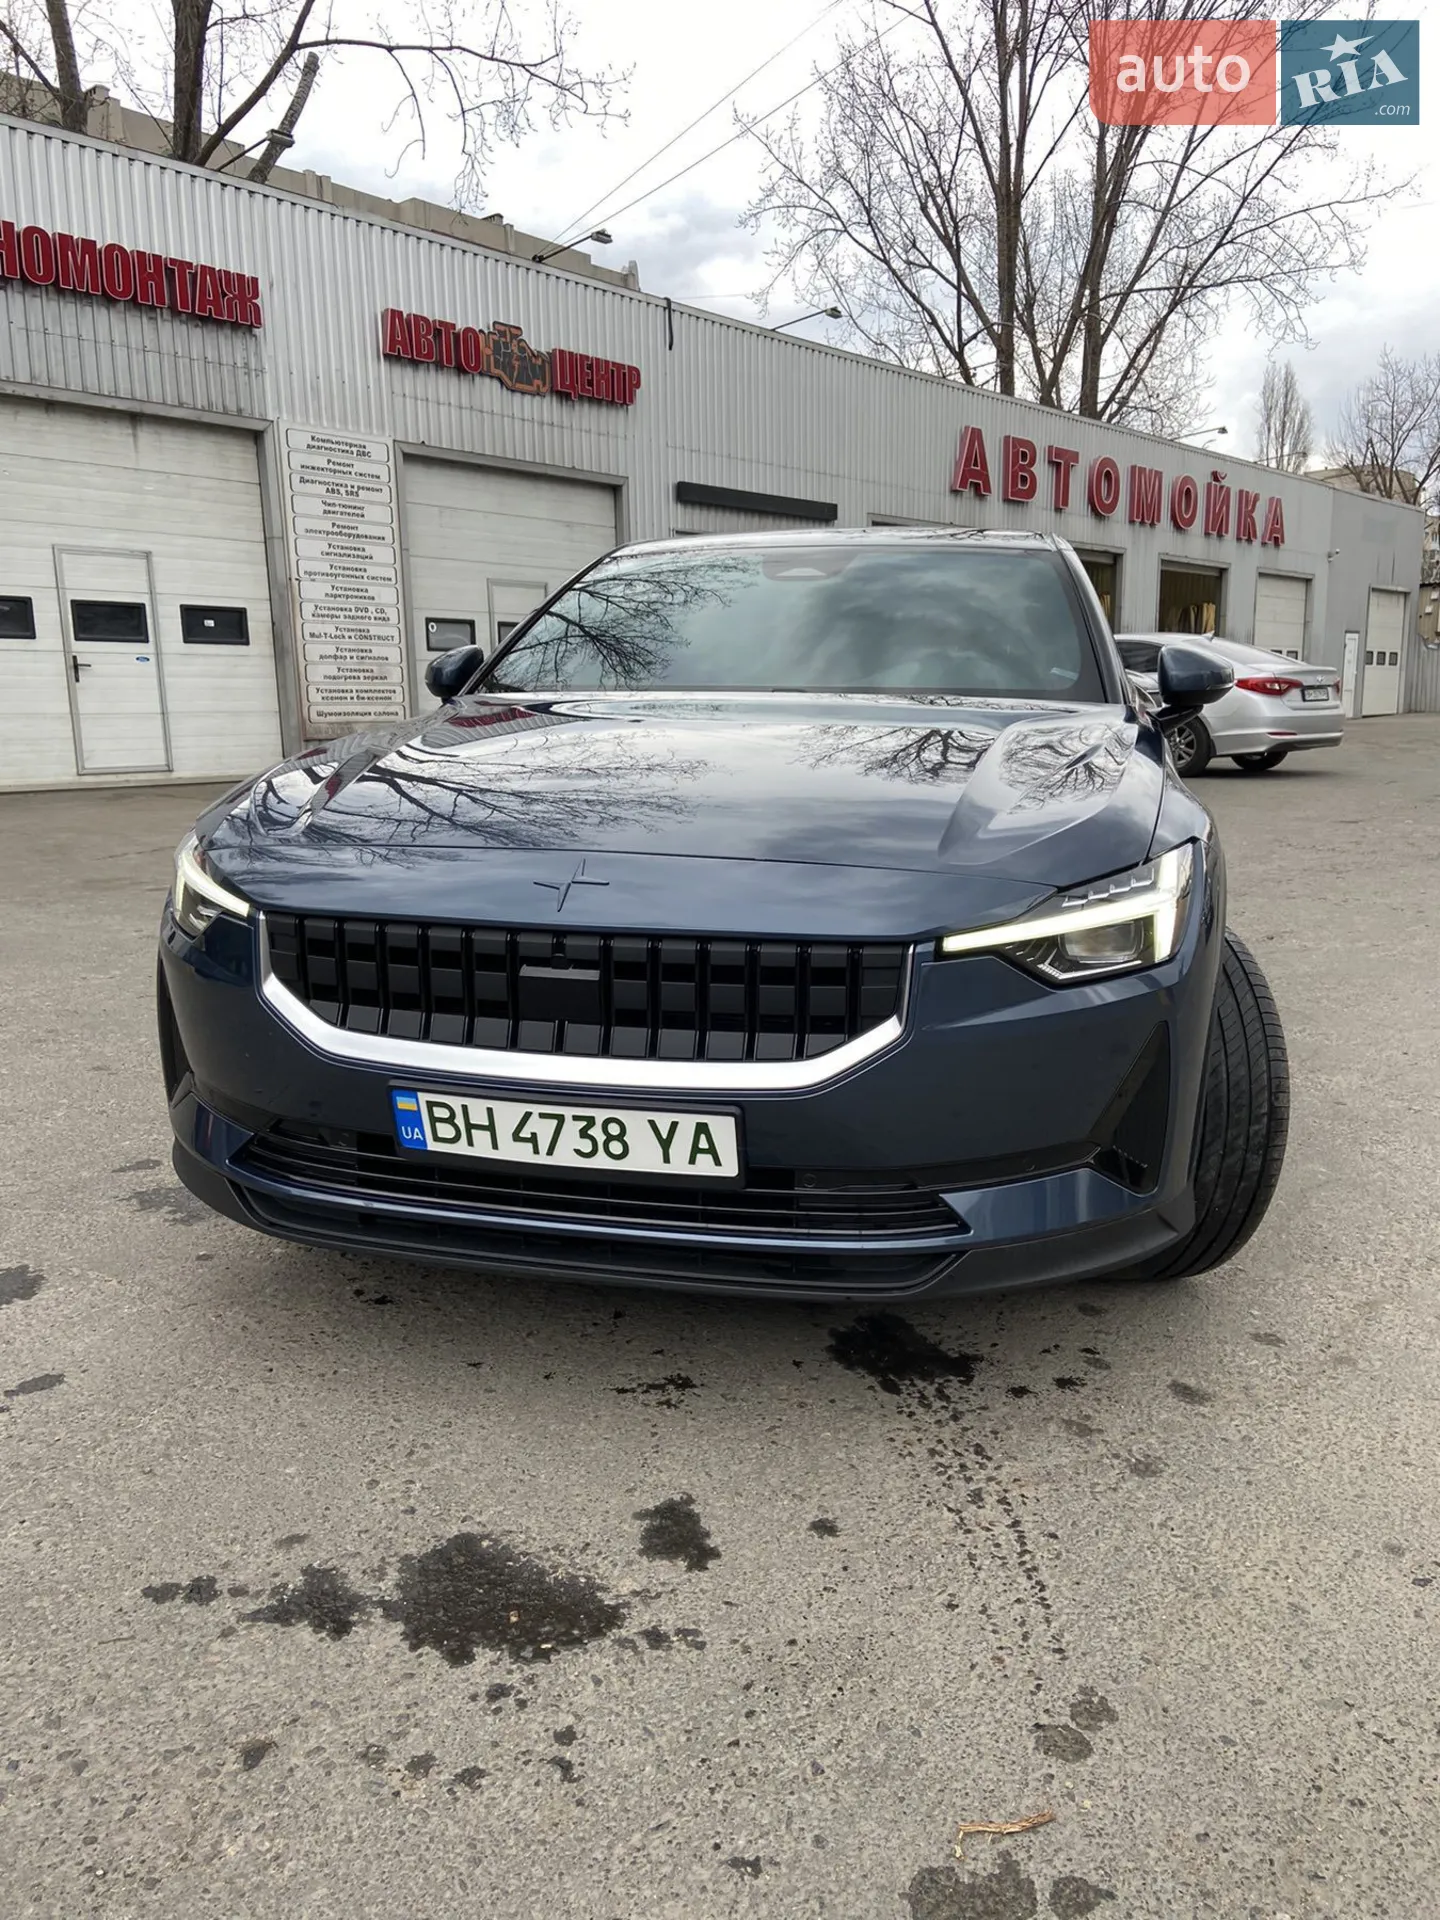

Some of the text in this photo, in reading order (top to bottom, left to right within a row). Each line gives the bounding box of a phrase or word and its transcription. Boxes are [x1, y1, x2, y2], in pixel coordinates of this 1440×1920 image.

[383, 308, 642, 406] АВТО ЦЕНТР
[310, 435, 367, 449] Компьютерная
[306, 444, 372, 458] диагностика ДВС
[326, 459, 355, 468] Ремонт
[300, 464, 381, 480] инжекторных систем
[299, 476, 349, 488] Диагностика
[356, 485, 383, 493] ремонт
[952, 425, 1285, 546] АВТОМОЙКА
[322, 509, 365, 518] двигателей
[331, 522, 359, 531] Ремонт
[304, 528, 386, 541] электрооборудования
[327, 543, 366, 552] Установка
[320, 551, 374, 560] сигнализаций
[329, 564, 367, 573] Установка
[303, 570, 393, 582] противоугонных систем
[330, 585, 369, 593] Установка
[324, 592, 376, 601] парктроников
[314, 604, 353, 613] Установка
[311, 612, 341, 620] камеры
[334, 626, 371, 634] Установка
[335, 646, 373, 654] Установка
[316, 710, 372, 718] Шумоизоляция
[402, 1126, 424, 1141] UA
[425, 1100, 722, 1167] BH 4738 YA
